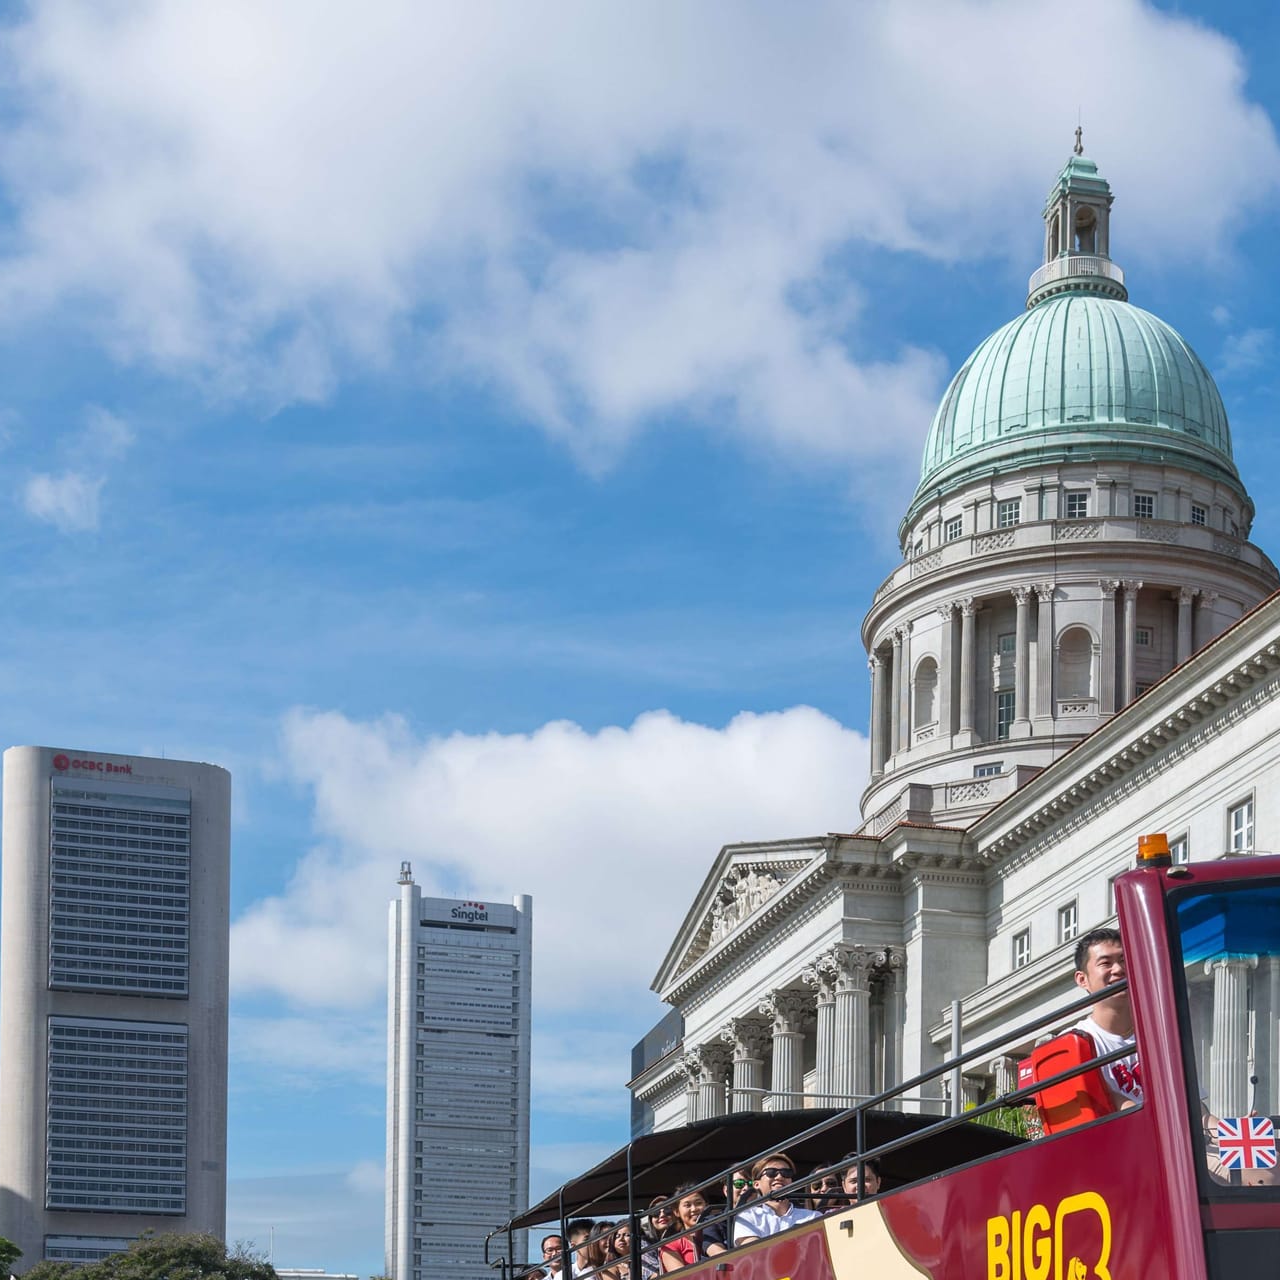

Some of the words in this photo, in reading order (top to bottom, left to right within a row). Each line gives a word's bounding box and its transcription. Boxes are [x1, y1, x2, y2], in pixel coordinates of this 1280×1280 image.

[71, 759, 103, 772] OCBC
[106, 763, 133, 775] Bank
[451, 905, 489, 923] Singtel
